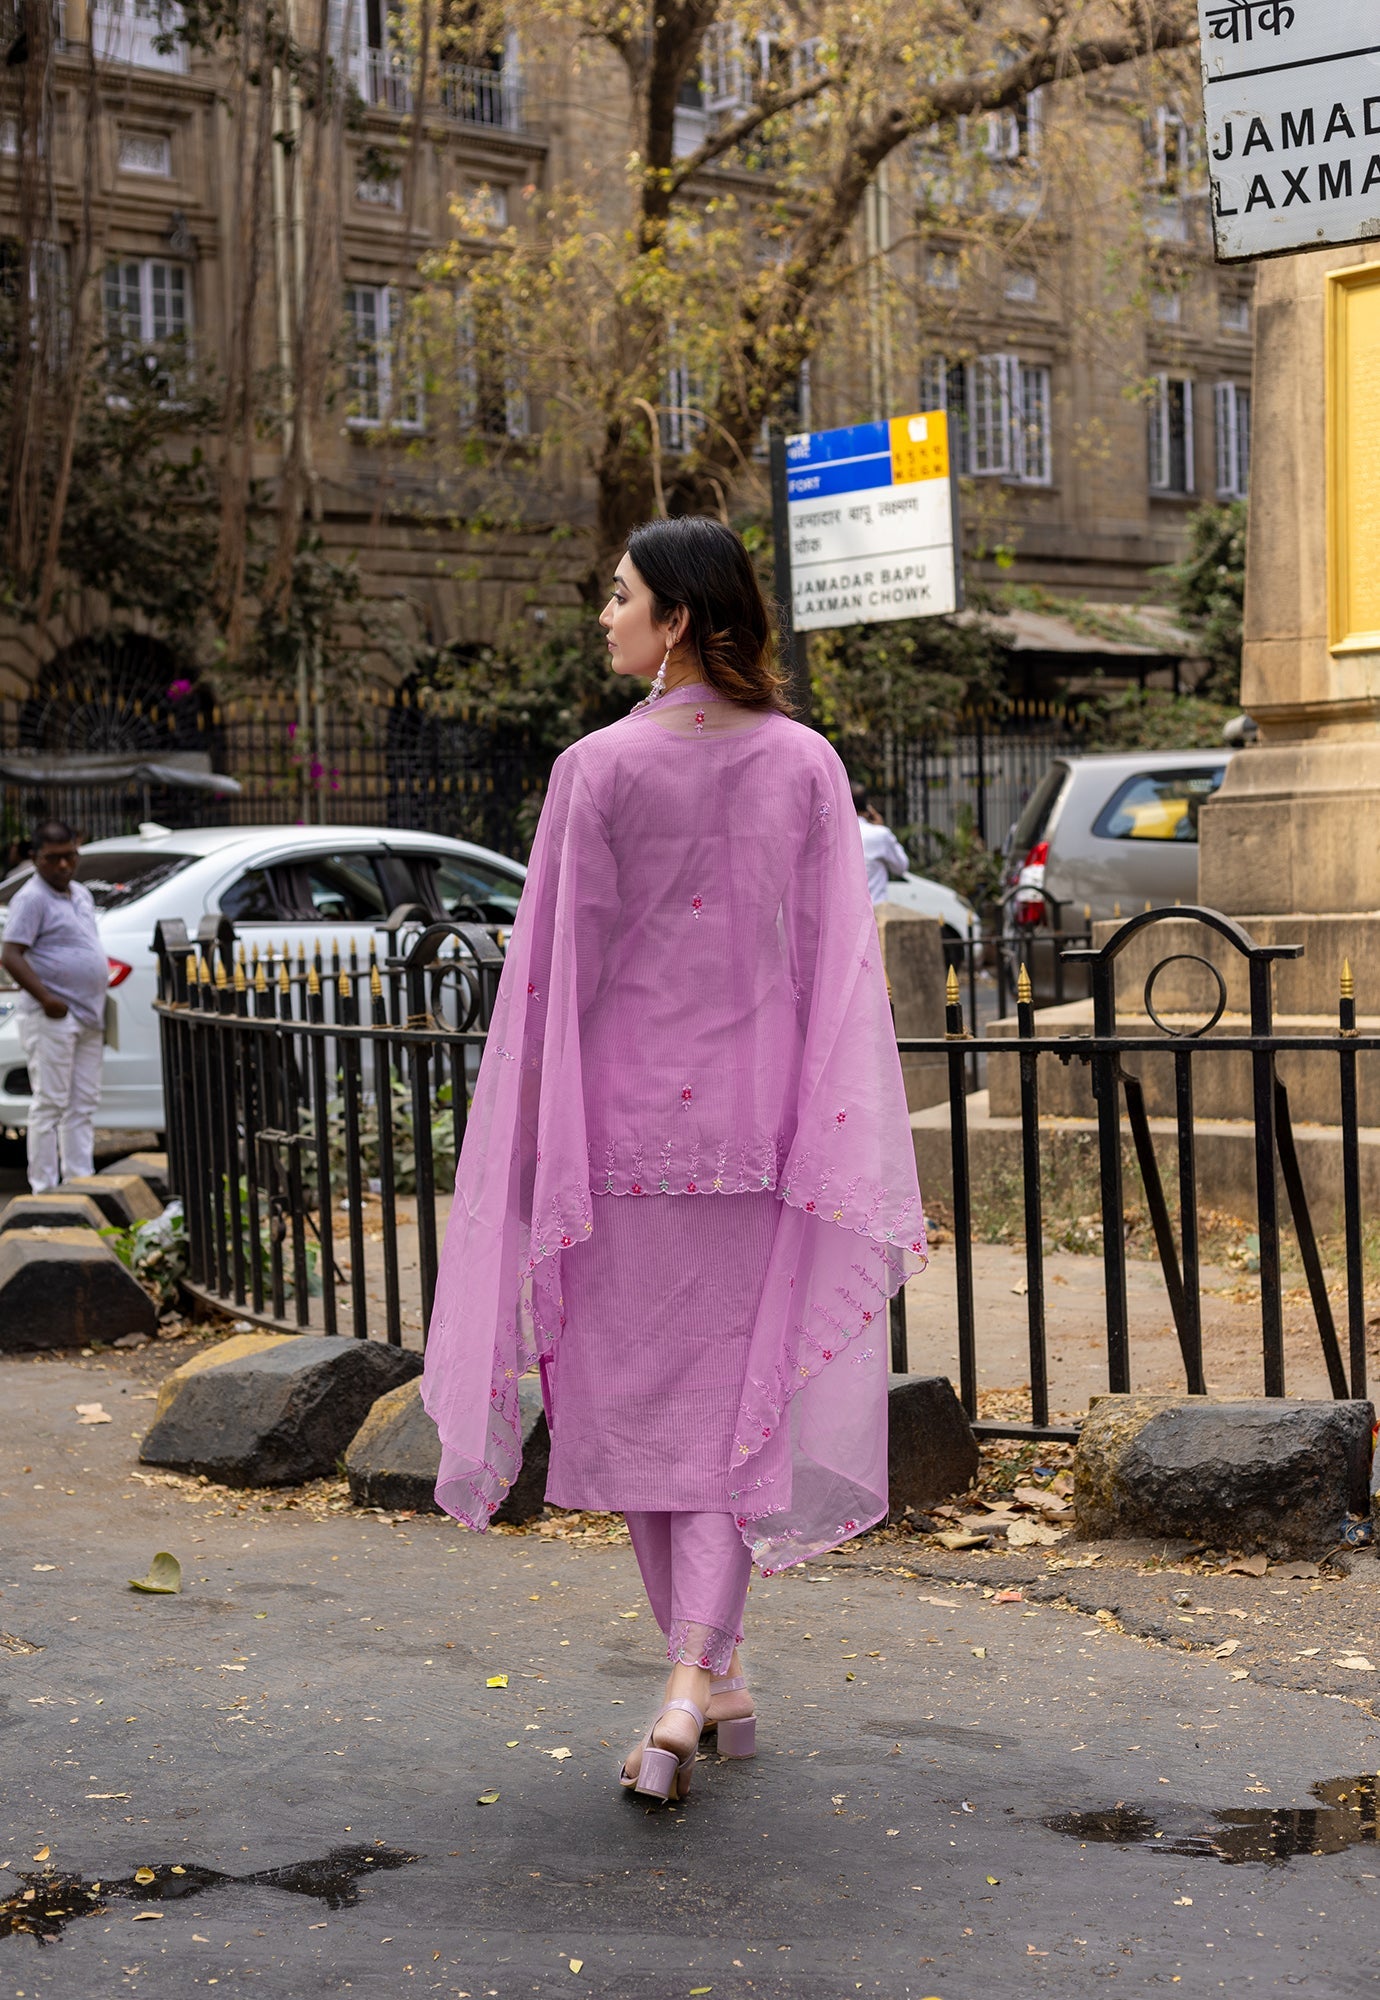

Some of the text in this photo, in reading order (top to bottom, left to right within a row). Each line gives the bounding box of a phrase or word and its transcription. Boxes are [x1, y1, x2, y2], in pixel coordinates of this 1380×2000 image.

[1211, 155, 1380, 217] LAXMA
[788, 476, 821, 493] FORT
[794, 564, 926, 597] JAMADAR BAPU
[794, 584, 932, 616] LAXMAN CHOWK
